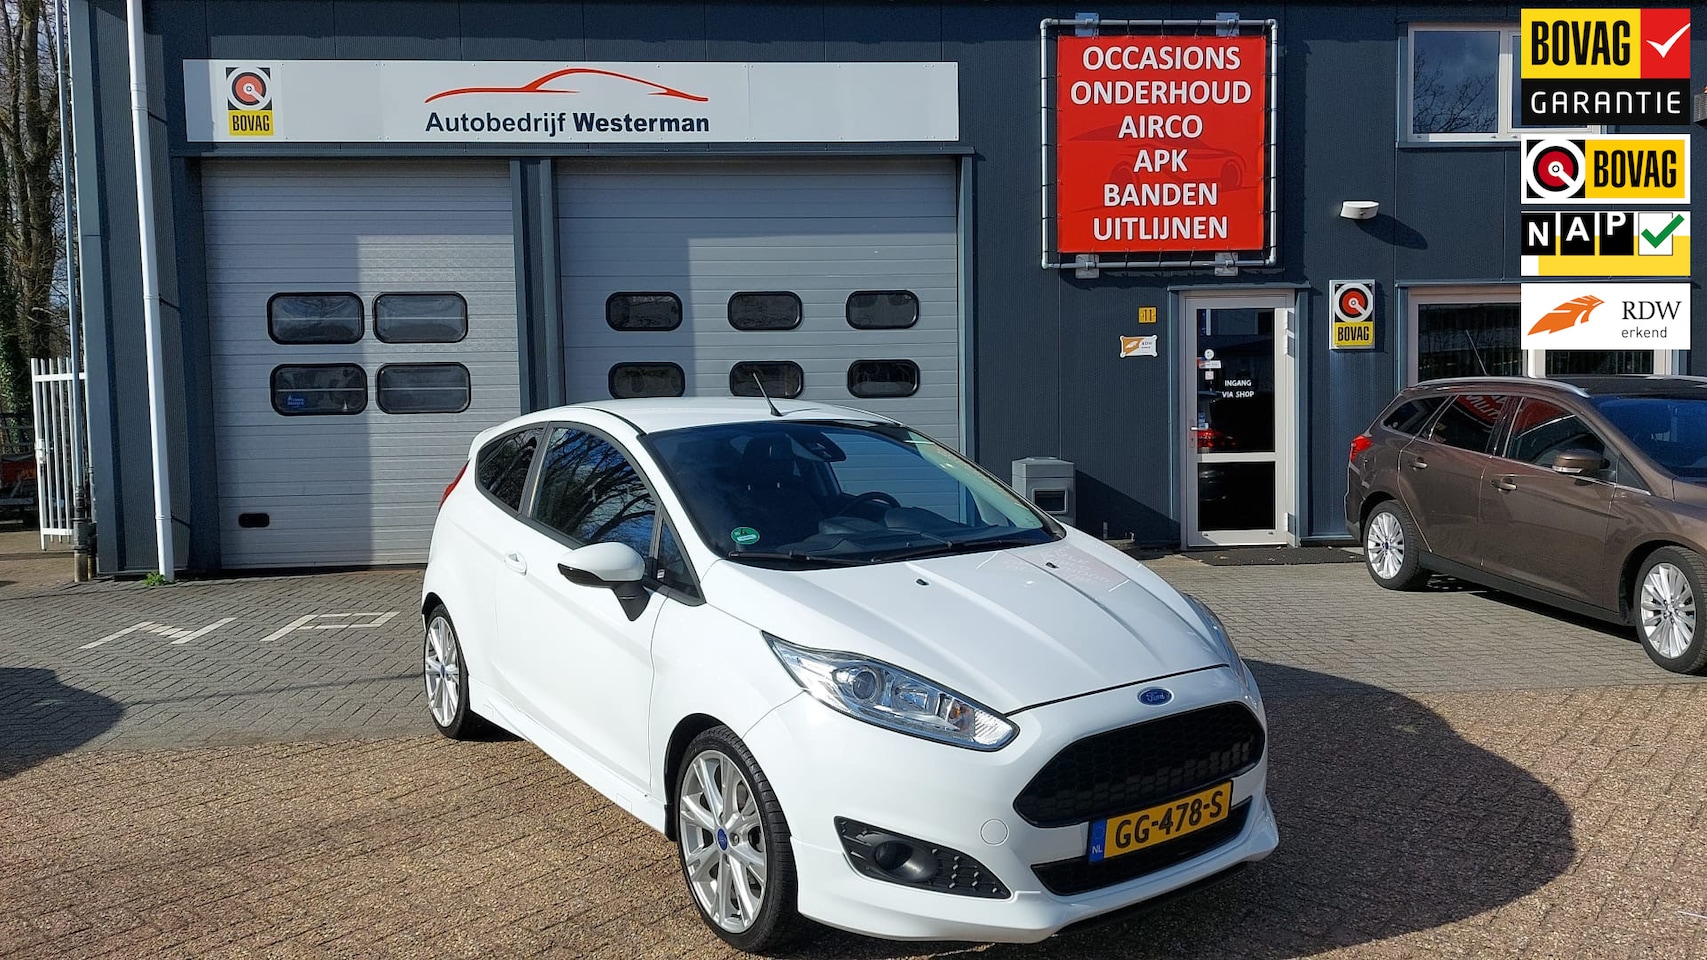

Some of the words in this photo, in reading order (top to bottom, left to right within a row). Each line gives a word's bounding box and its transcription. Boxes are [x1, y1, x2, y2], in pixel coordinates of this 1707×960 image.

[1082, 46, 1241, 70] OCCASIONS
[1070, 81, 1251, 105] ONDERHOUD
[232, 114, 270, 132] BOVAG
[425, 112, 566, 137] Autobedrijf
[572, 112, 710, 132] Westerman
[1118, 115, 1203, 138] AIRCO
[1133, 149, 1188, 172] APK
[1104, 183, 1217, 206] BANDEN
[1093, 216, 1228, 240] UITLIJNEN
[1337, 326, 1370, 341] BOVAG
[1115, 790, 1223, 849] GG-478-S
[1091, 845, 1103, 854] NL
